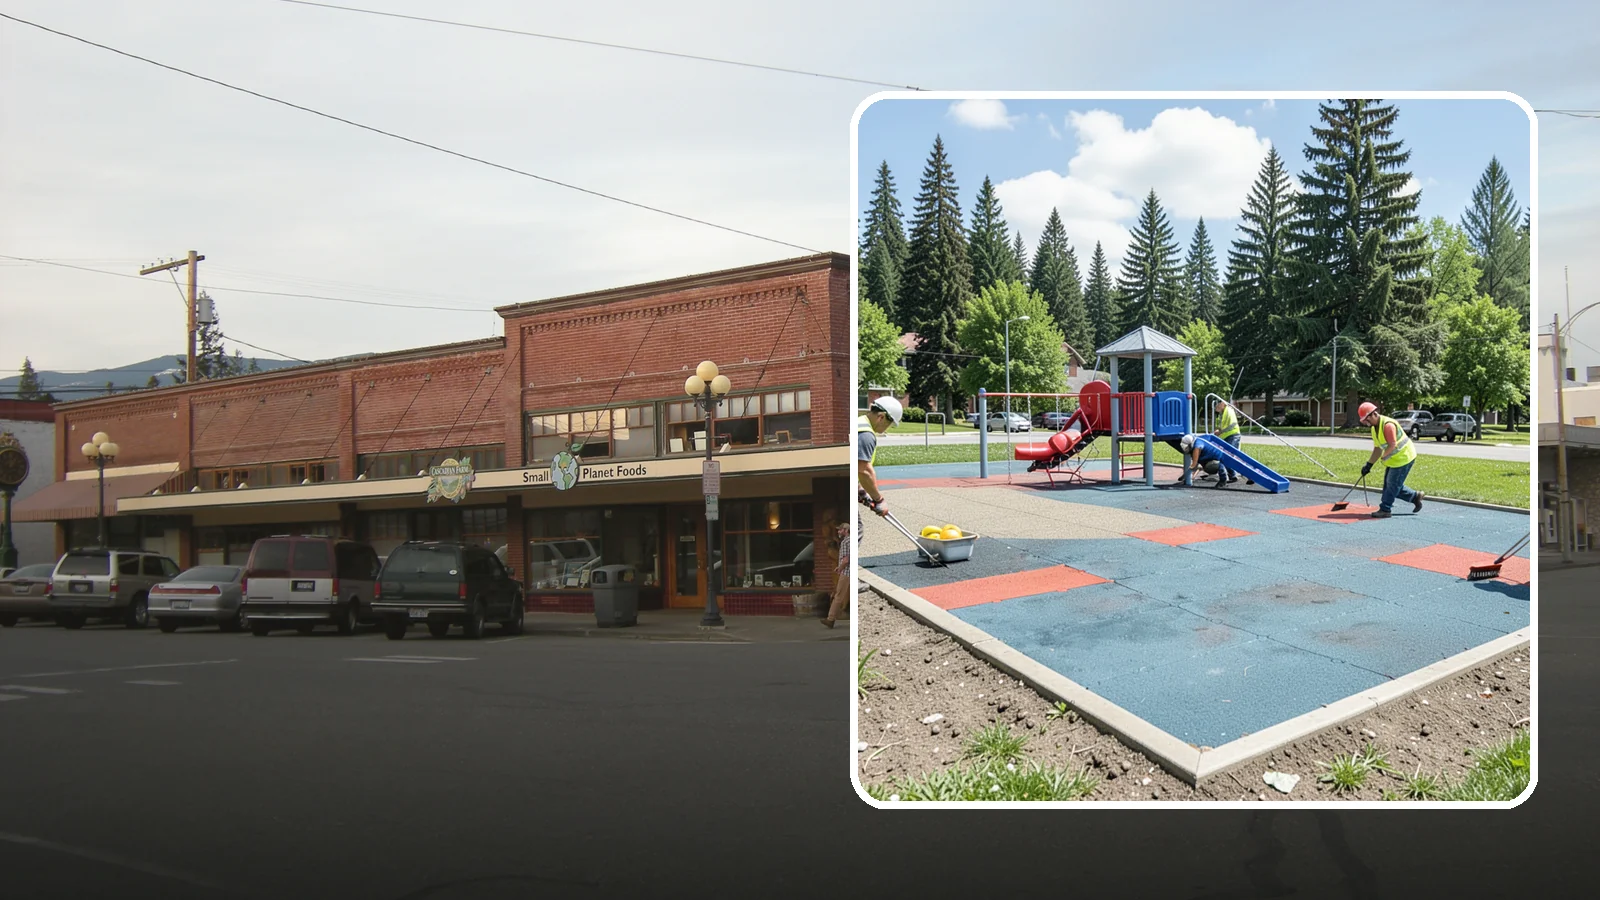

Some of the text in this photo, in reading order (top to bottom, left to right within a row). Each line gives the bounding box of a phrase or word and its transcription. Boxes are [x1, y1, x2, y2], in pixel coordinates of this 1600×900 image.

[523, 464, 647, 483] Small Planet Foods
